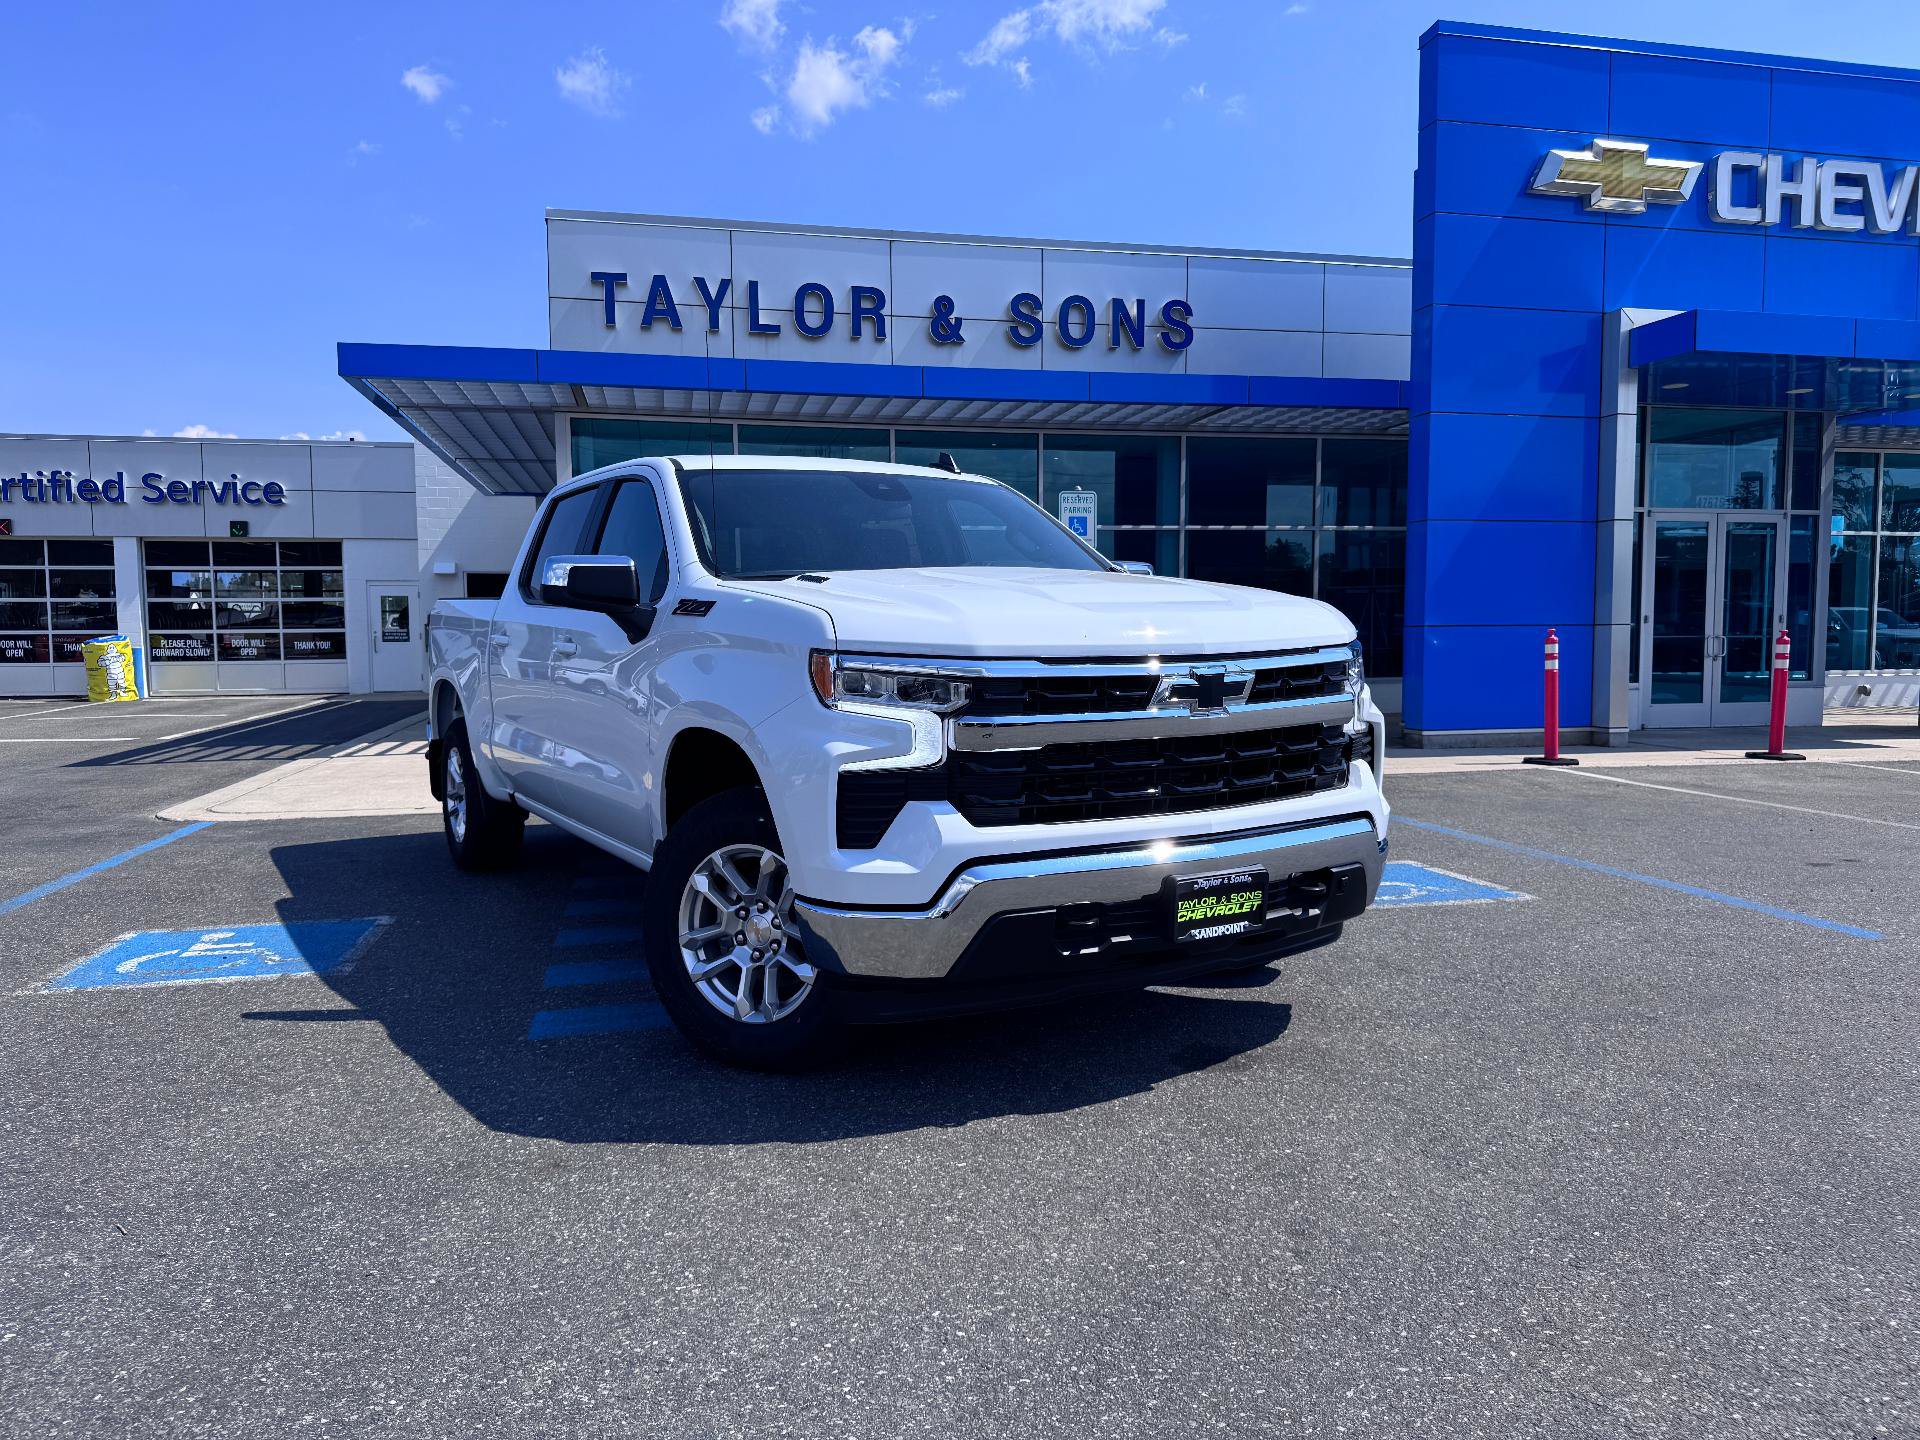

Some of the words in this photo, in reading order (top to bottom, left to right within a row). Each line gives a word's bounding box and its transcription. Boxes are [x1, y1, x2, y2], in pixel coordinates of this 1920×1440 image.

[1708, 151, 1920, 235] CHEV
[590, 271, 887, 341] TAYLOR
[929, 294, 966, 344] &
[1007, 291, 1196, 352] SONS
[0, 470, 125, 502] rtified
[142, 472, 287, 506] Service
[1062, 495, 1094, 504] RESERVED
[1063, 506, 1092, 514] PARKING
[16, 640, 33, 649] WILL
[63, 643, 81, 652] THAN
[160, 639, 187, 648] PLEASE
[187, 639, 203, 648] PULL
[231, 639, 249, 648] DOOR
[249, 639, 267, 648] WILL
[293, 641, 315, 650] THANK
[315, 641, 331, 650] YOU!
[5, 648, 24, 657] OPEN
[152, 648, 185, 657] FORWARD
[185, 648, 211, 657] SLOWLY
[240, 647, 258, 656] OPEN
[1198, 877, 1222, 889] Taylor
[1230, 874, 1249, 884] Sons
[1177, 896, 1217, 910] TAYLOR
[1220, 895, 1227, 905] &
[1230, 890, 1263, 903] SONS
[1177, 901, 1262, 922] CHEVROLET
[1194, 922, 1246, 940] SANDPOINT
